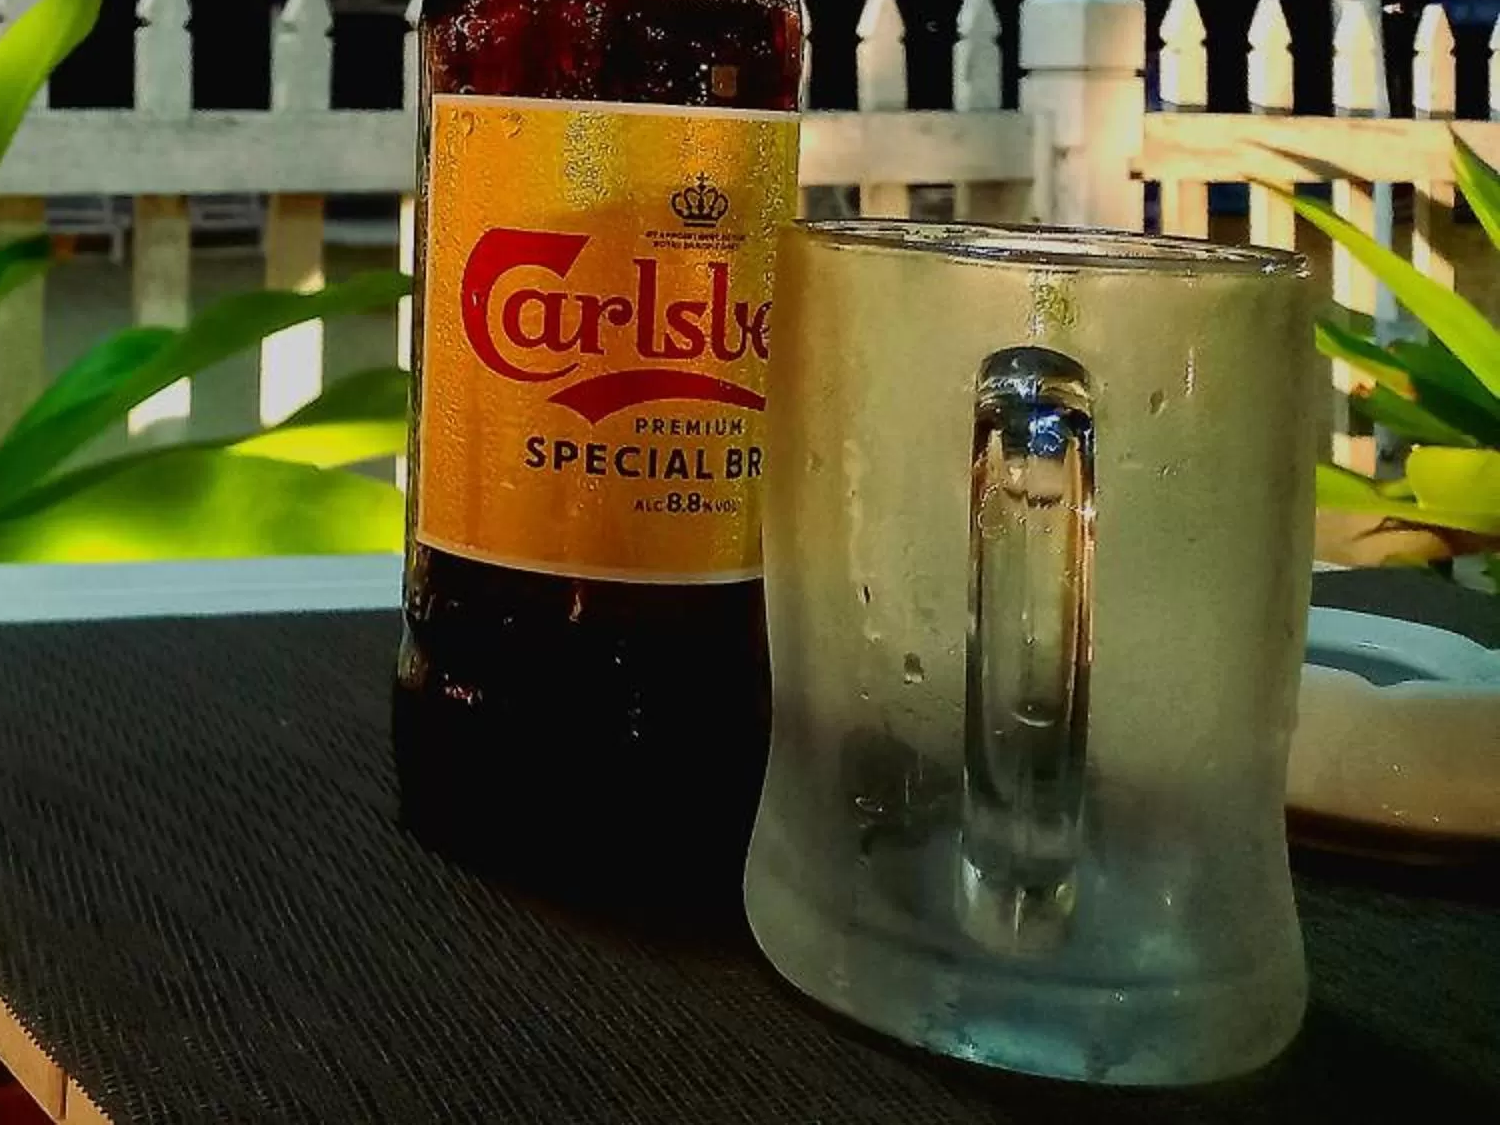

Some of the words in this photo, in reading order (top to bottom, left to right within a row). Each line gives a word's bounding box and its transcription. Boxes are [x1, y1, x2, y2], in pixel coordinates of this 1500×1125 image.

[635, 418, 744, 436] PREMIUM
[524, 435, 714, 480] SPECIAL
[726, 447, 762, 479] BR
[634, 499, 664, 513] ALC
